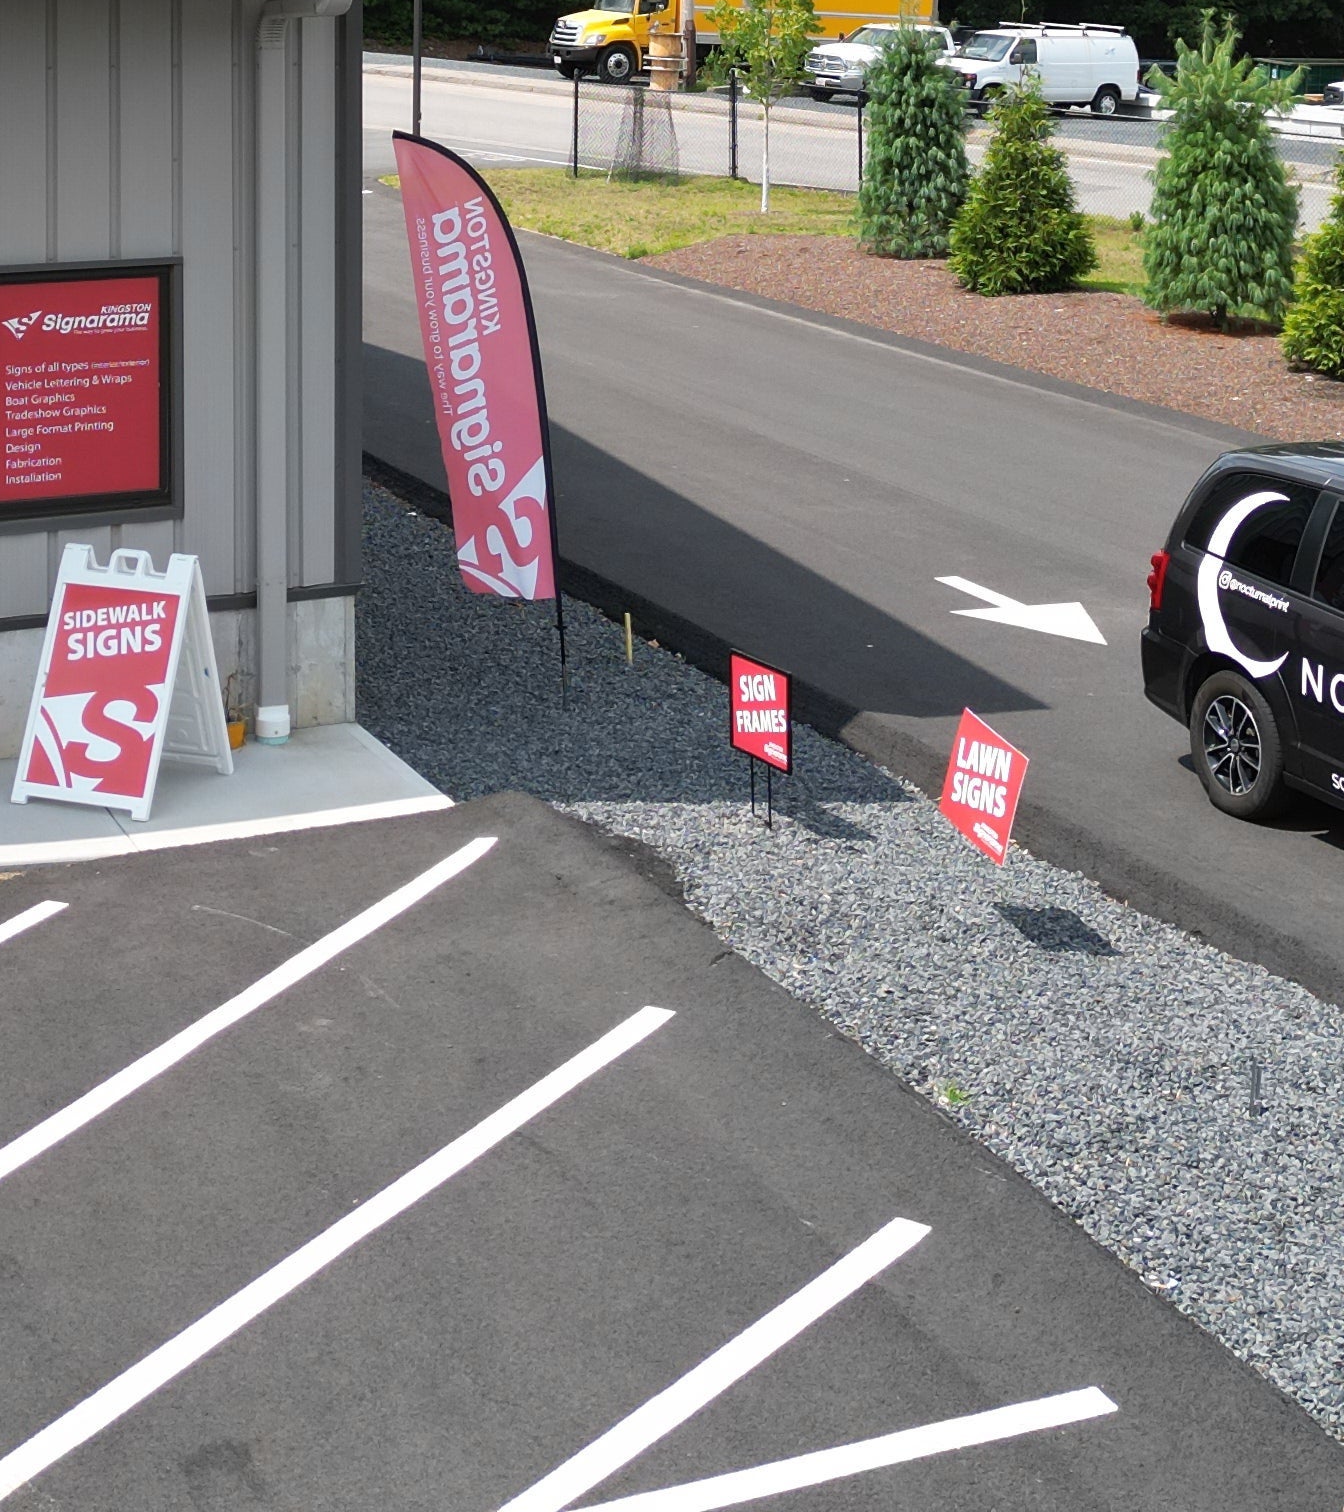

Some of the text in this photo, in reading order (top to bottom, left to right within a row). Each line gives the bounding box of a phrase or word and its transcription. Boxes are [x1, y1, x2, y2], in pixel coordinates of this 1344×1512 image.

[101, 303, 151, 314] KINGSTON
[42, 312, 149, 334] Signarama
[5, 365, 32, 377] Signs
[35, 361, 46, 373] of
[48, 361, 59, 372] all
[61, 361, 89, 373] types
[5, 374, 133, 391] Vehicle Lettering & Wraps
[5, 393, 75, 406] Boat Graphics
[5, 404, 107, 420] Tradeshow Graphics
[5, 421, 114, 438] Large Format Printing
[5, 443, 41, 454] Design
[5, 457, 62, 468] Fabrication
[5, 472, 62, 484] Installation
[63, 600, 166, 630] SIDEWALK
[67, 623, 163, 661] SIGNS
[739, 674, 776, 702] SIGN
[736, 709, 787, 734] FRAMES
[956, 737, 1012, 783] LAWN
[950, 771, 1007, 819] SIGNS
